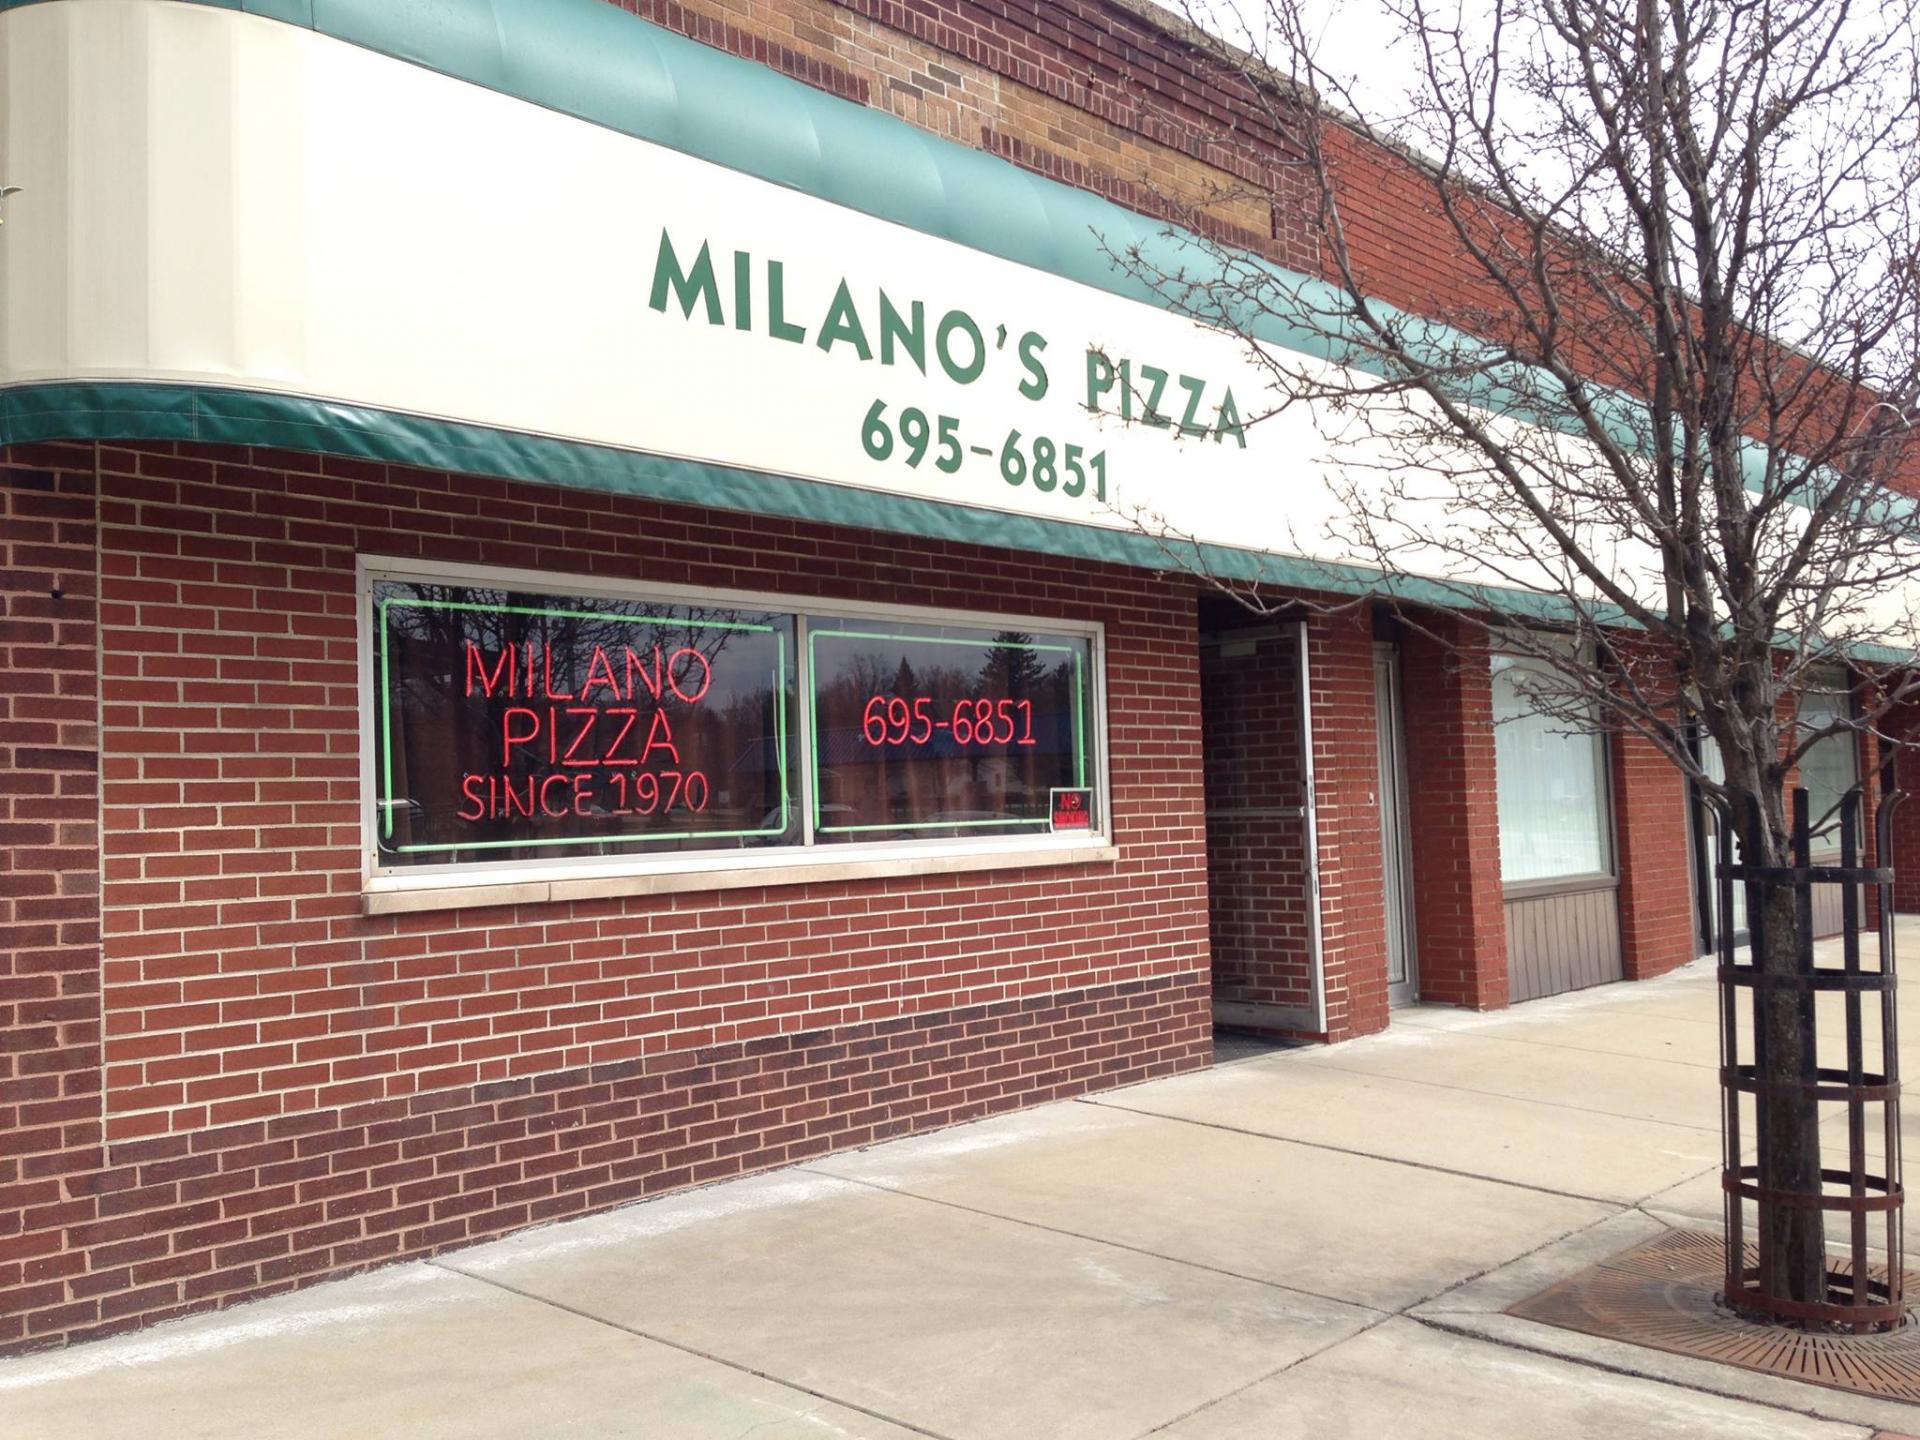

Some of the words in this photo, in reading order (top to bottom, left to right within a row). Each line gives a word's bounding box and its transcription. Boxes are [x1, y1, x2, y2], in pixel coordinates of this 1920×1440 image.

[649, 227, 1049, 401] MILANO'S
[1086, 350, 1246, 449] PIZZA
[861, 399, 1107, 502] 695-6851
[465, 640, 711, 702] MILANO
[503, 707, 680, 767] PIZZA
[865, 697, 1036, 745] 695-6851
[457, 774, 593, 821] SINCE
[610, 771, 708, 815] 1970
